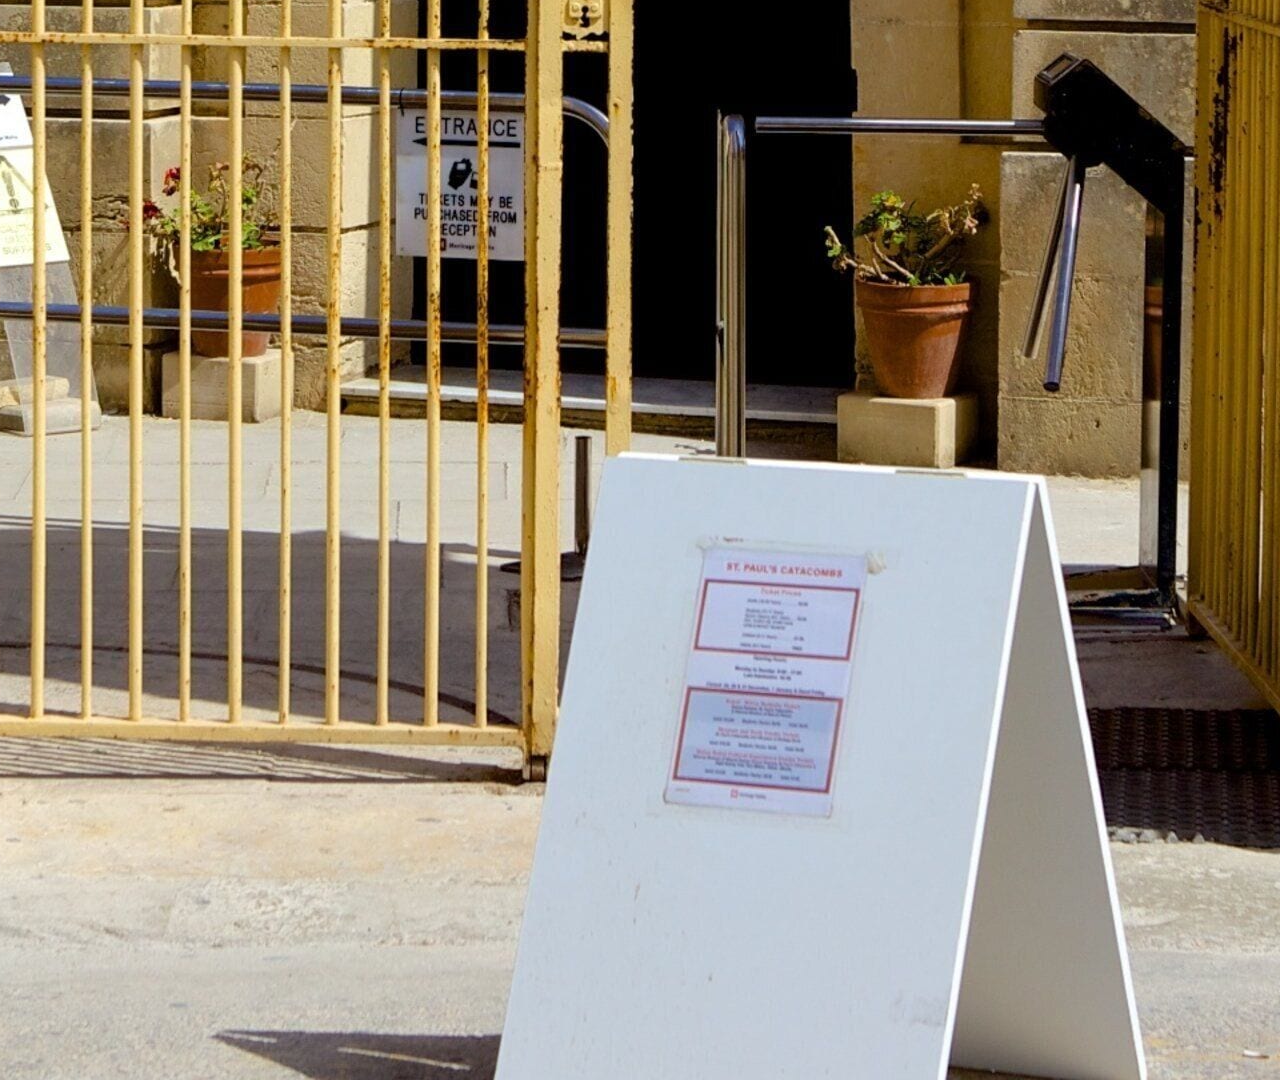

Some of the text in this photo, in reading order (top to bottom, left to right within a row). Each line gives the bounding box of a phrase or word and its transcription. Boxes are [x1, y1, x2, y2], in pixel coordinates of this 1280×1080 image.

[415, 116, 517, 137] ETRACE
[470, 195, 494, 208] MY
[499, 196, 513, 209] BE
[439, 223, 497, 238] ECEPTN
[726, 562, 843, 578] ST. PAUL'S CATACOMBS
